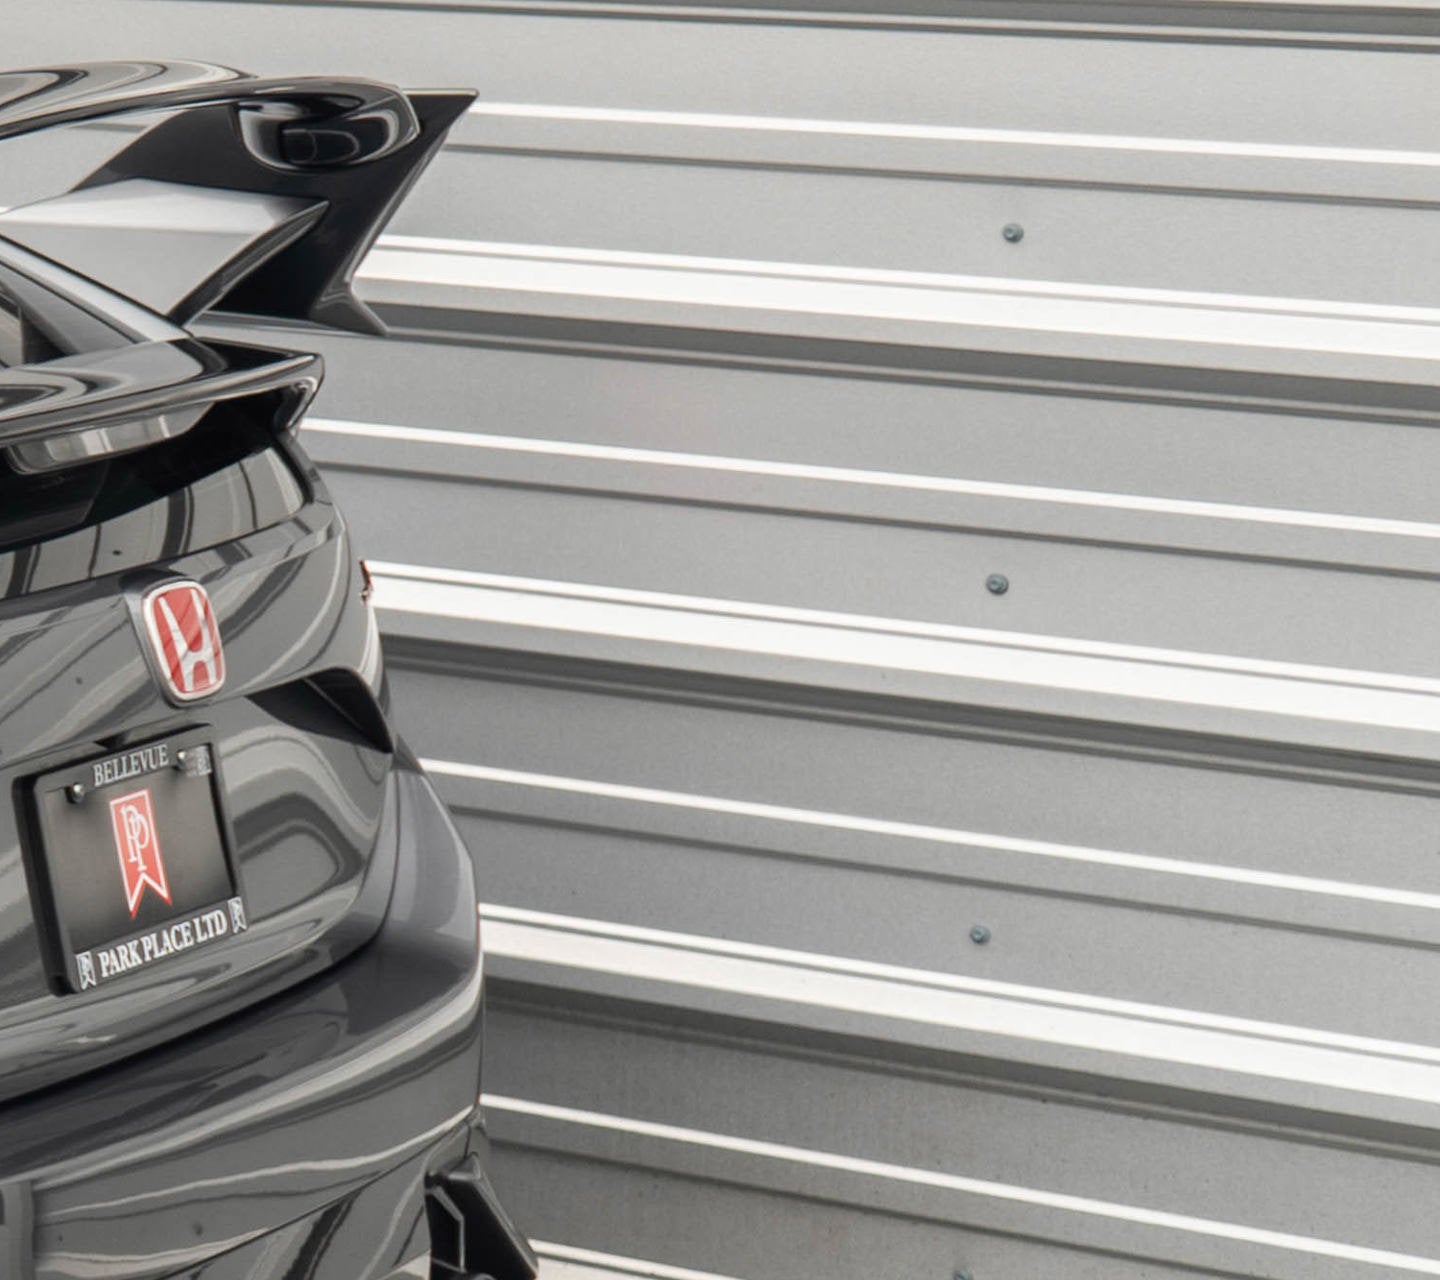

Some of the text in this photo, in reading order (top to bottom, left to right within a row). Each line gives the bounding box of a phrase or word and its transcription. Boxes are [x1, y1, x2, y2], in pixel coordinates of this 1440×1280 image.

[93, 744, 169, 787] BELLEVUE
[98, 939, 143, 978] PARK
[140, 922, 194, 962] PLACE
[192, 909, 228, 943] LTD
